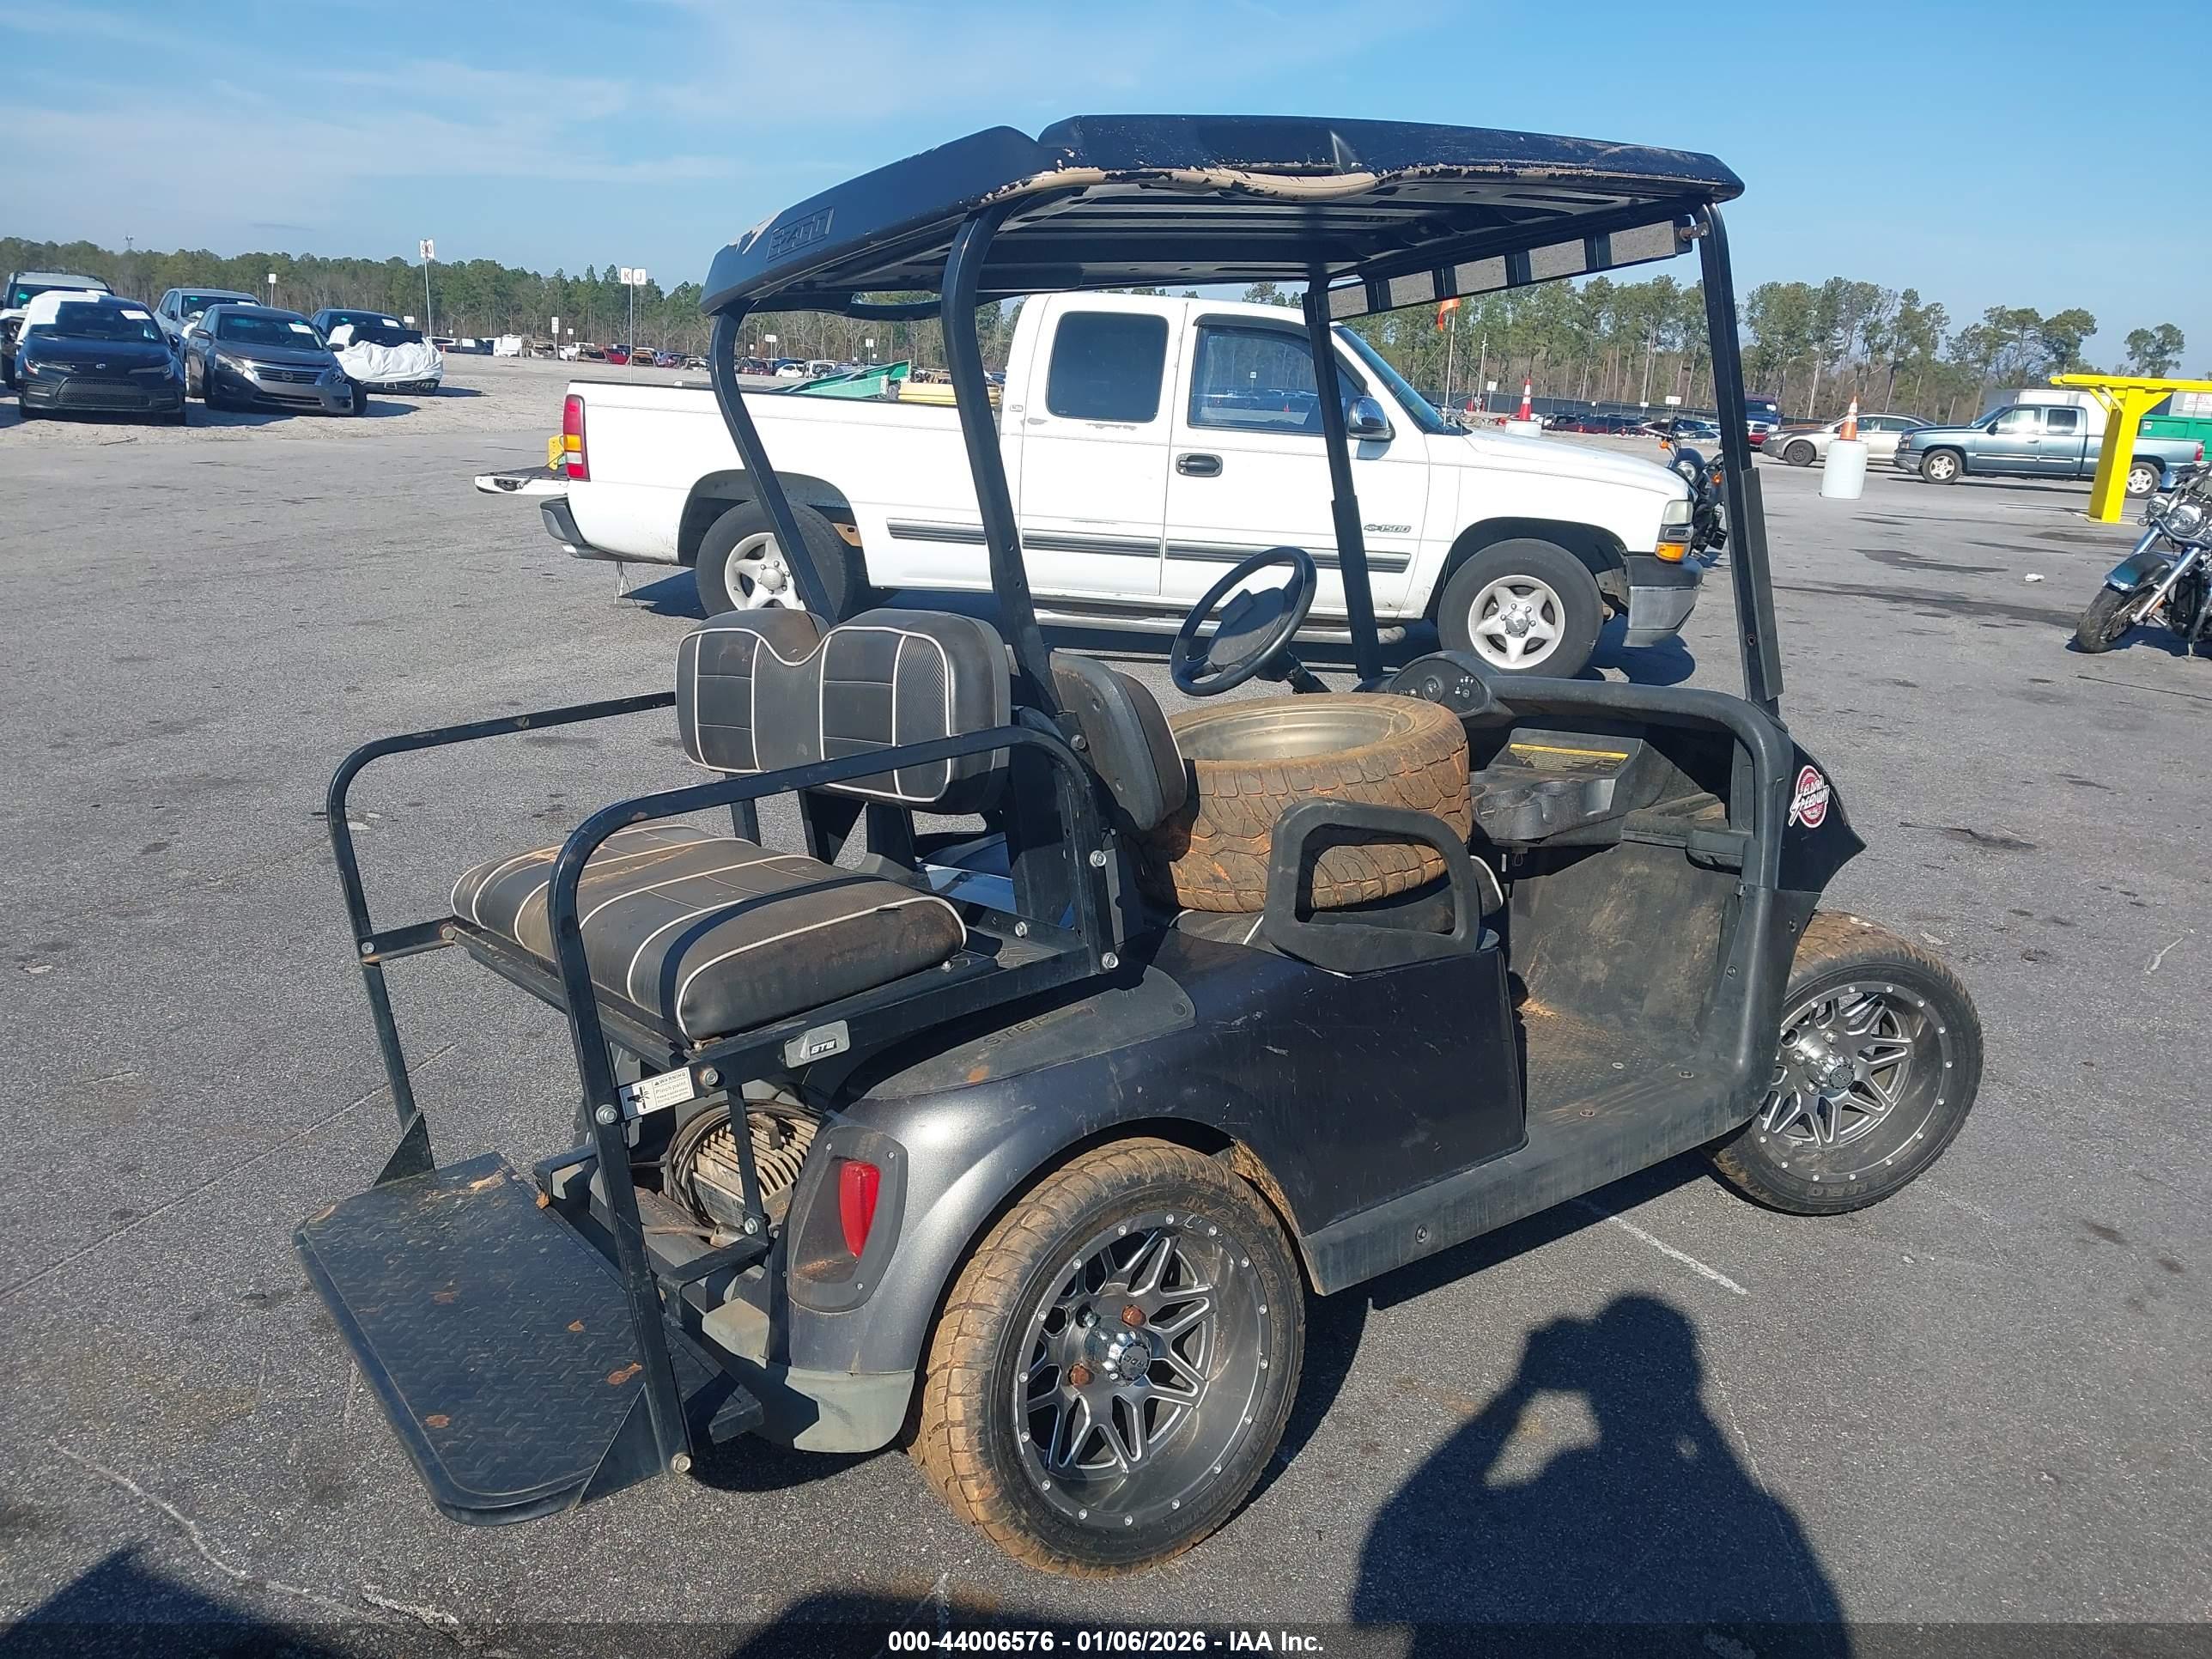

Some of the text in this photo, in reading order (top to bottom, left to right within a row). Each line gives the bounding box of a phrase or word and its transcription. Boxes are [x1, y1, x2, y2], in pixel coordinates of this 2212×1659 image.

[1380, 524, 1412, 533] 1500
[810, 1039, 836, 1055] GTW
[659, 1072, 686, 1085] WARNING
